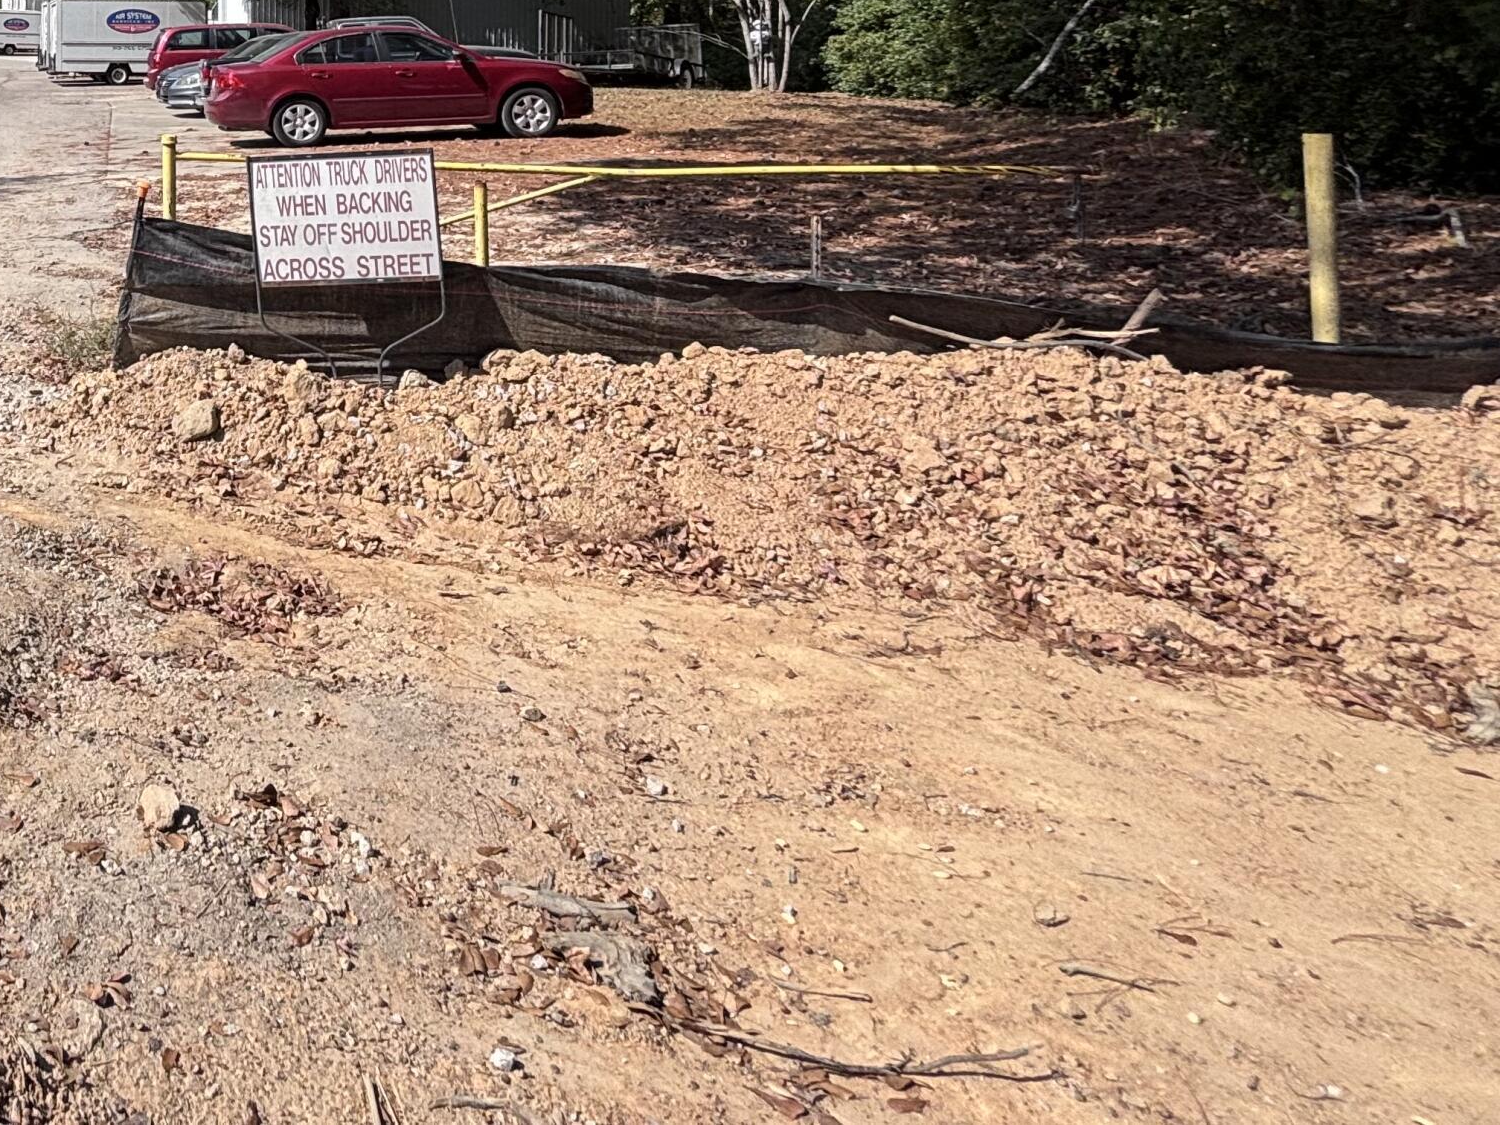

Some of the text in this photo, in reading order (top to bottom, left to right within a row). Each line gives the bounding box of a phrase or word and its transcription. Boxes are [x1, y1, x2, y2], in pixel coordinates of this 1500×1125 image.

[256, 157, 427, 189] ATTENTION TRUCK DRIVERS
[276, 190, 412, 217] WHEN BACKING
[260, 219, 432, 247] STAY OFF SHOULDER
[264, 253, 433, 280] ACROSS STREET
